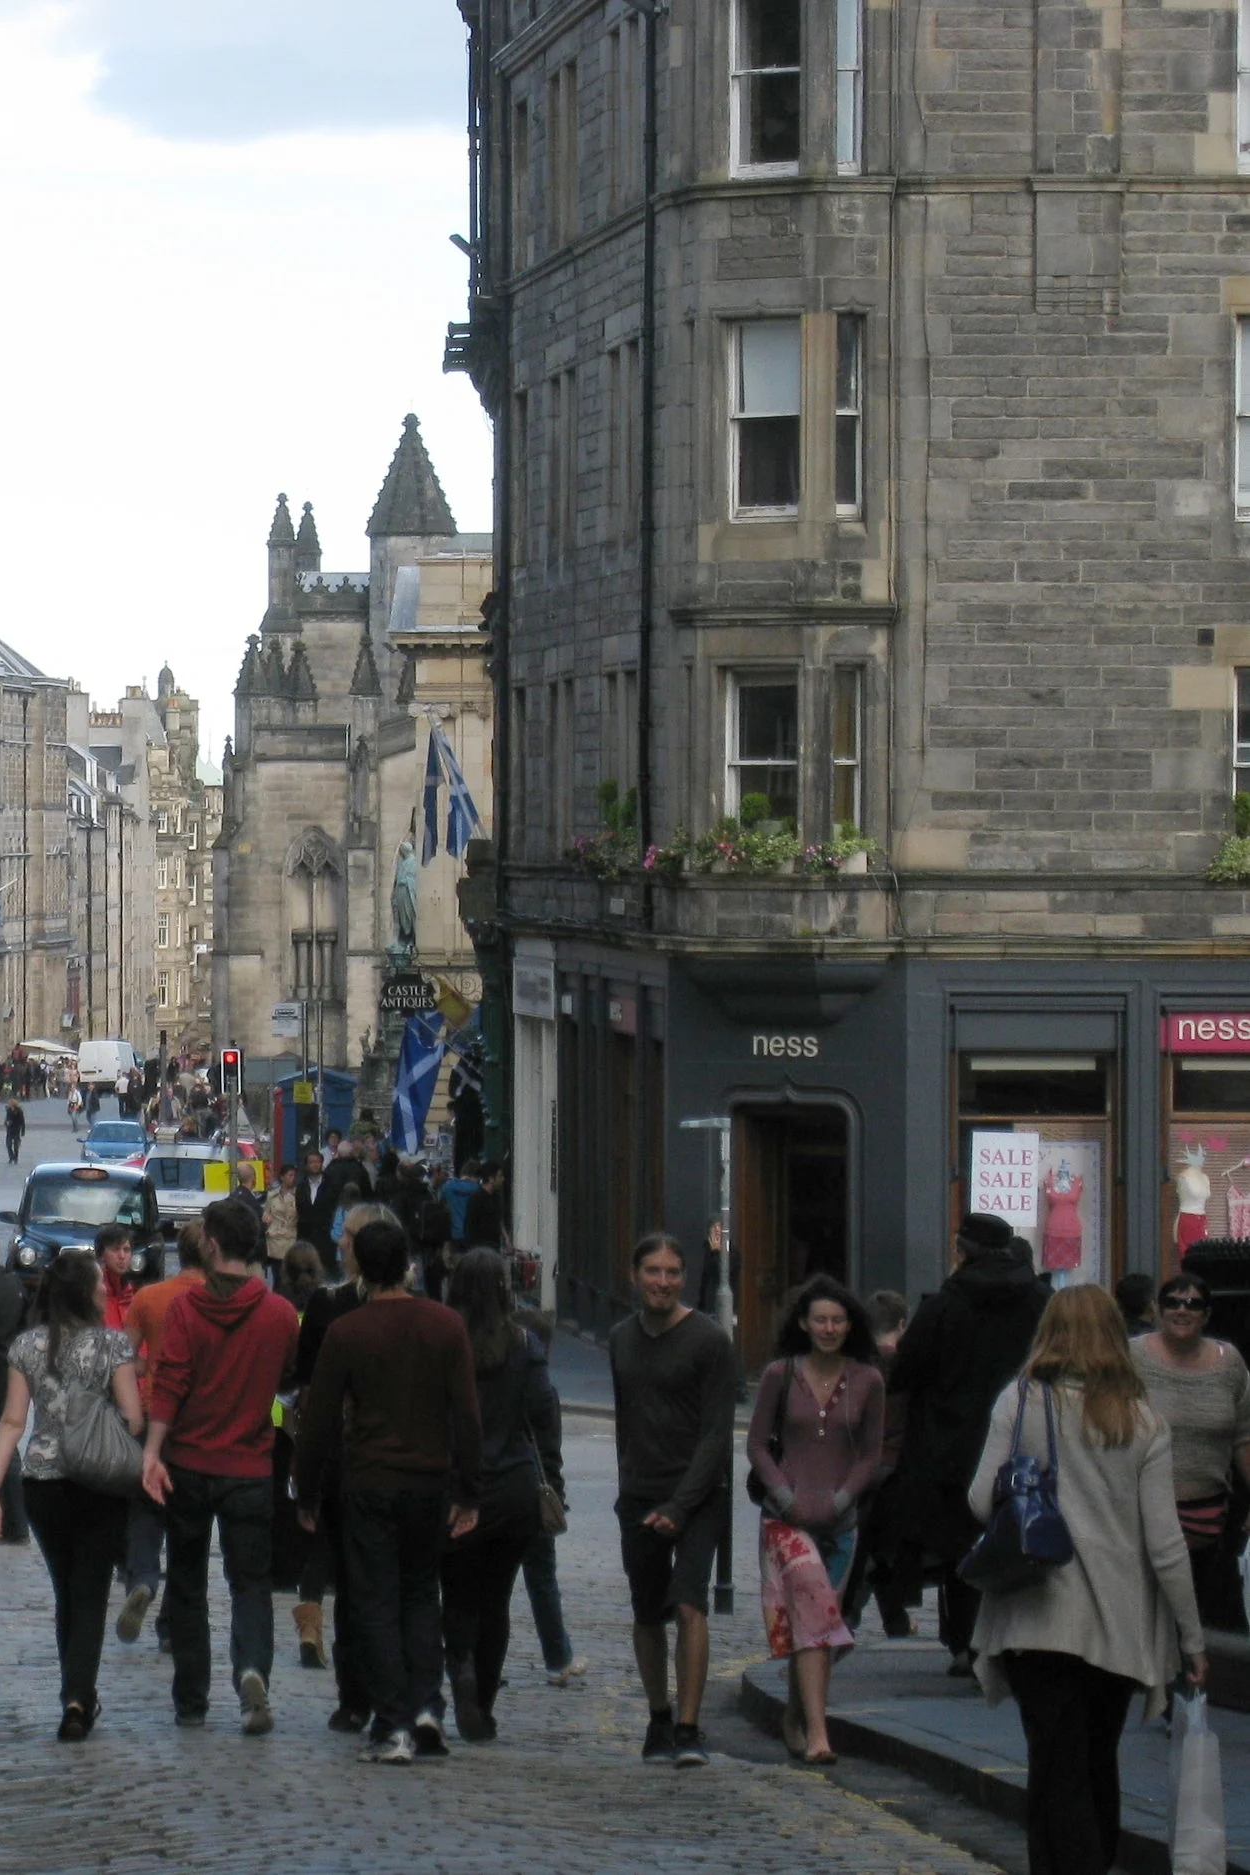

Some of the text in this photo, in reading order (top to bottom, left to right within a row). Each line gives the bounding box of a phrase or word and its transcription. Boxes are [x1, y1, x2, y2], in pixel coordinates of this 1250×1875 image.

[387, 985, 428, 997] CASTLE
[381, 996, 435, 1009] ANTIQUES
[1178, 1018, 1250, 1041] ness
[752, 1035, 819, 1058] ness
[979, 1148, 1034, 1166] SALE
[979, 1171, 1033, 1189] SALE
[977, 1193, 1033, 1212] SALE
